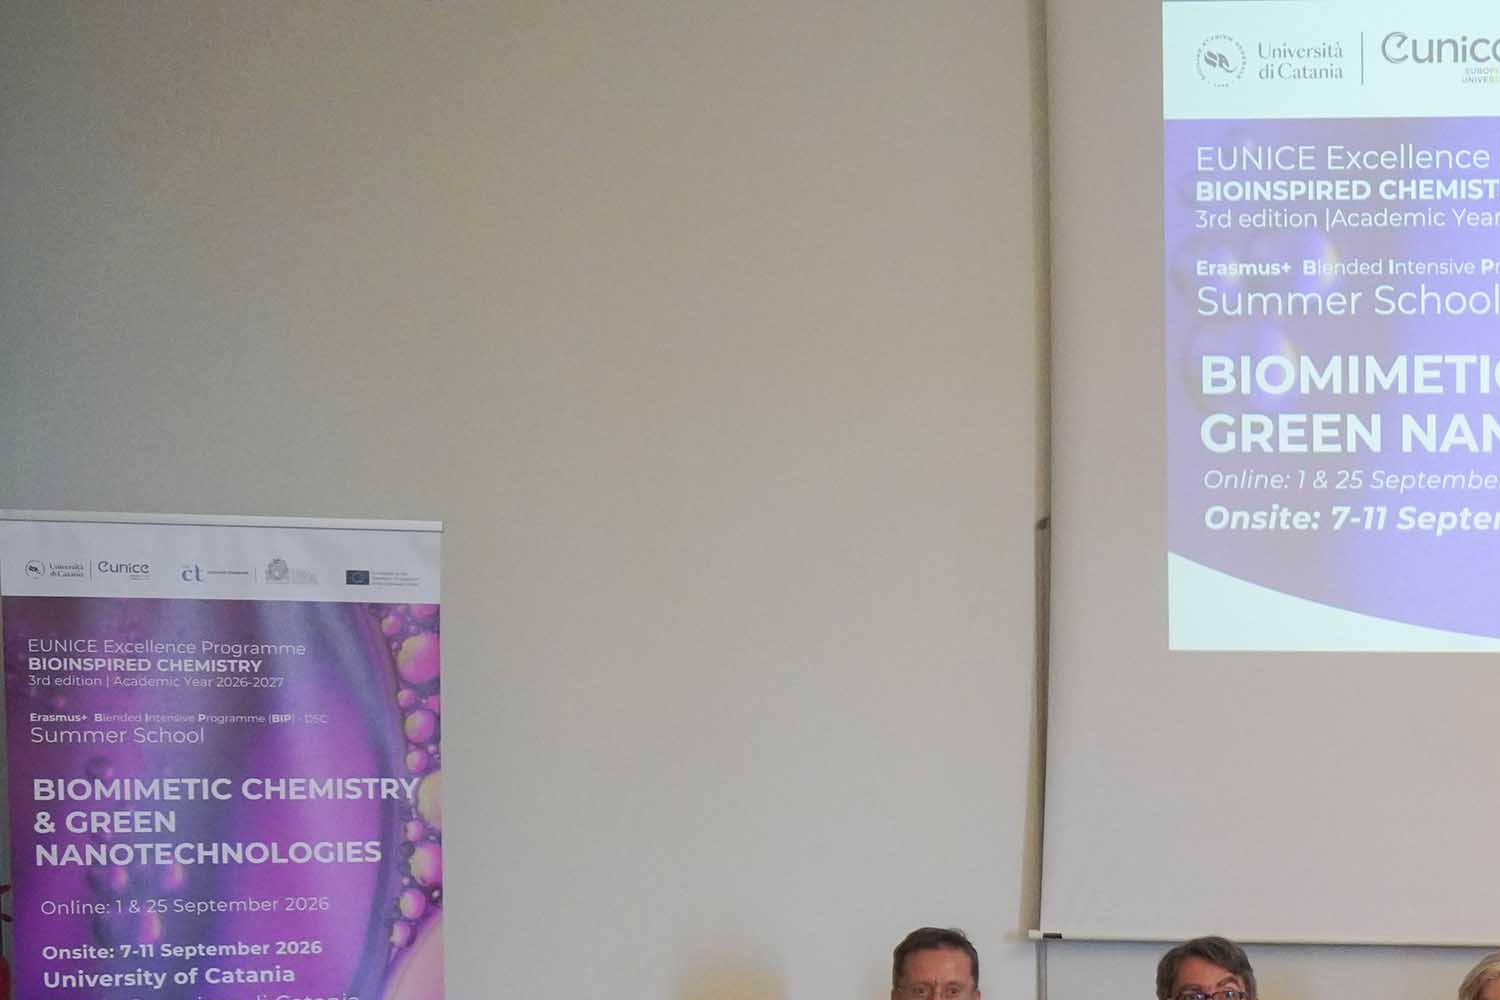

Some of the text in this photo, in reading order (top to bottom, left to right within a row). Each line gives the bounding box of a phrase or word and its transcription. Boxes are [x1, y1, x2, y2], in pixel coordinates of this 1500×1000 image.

[1258, 41, 1344, 59] Università
[1277, 63, 1344, 80] Catania
[1197, 143, 1315, 171] EUNICE
[1327, 143, 1490, 170] Excellence
[1196, 179, 1371, 201] BIOINSPIRED
[1195, 208, 1231, 228] 3rd
[1238, 207, 1317, 228] edition
[1196, 259, 1291, 278] Erasmus+
[1302, 258, 1382, 276] Blended
[1388, 258, 1475, 275] Intensive
[1197, 282, 1499, 316] Summer School
[1200, 413, 1381, 453] GREEN
[1204, 469, 1290, 488] Online:
[1296, 470, 1306, 488] 1
[1312, 470, 1327, 488] &
[1335, 469, 1363, 489] 25
[1204, 503, 1320, 530] Onsite:
[1331, 505, 1387, 530] 7-11
[28, 638, 306, 658] EUNICE Excellence Programme
[28, 656, 262, 672] BIOINSPIRED CHEMISTRY
[28, 674, 284, 688] 3rd edition Academic Year 2026-2027
[30, 712, 87, 722] Erasmus+
[197, 712, 265, 724] Programme
[268, 713, 294, 723] (BIP)
[30, 726, 204, 744] Summer School
[33, 777, 422, 802] BIOMIMETIC CHEMISTRY
[33, 810, 175, 833] & GREEN
[36, 840, 381, 868] NANOTECHNOLOGIES
[40, 896, 330, 915] Online: 1 & 25 September 2026
[42, 940, 322, 960] Onsite: 7-11 September 2026
[44, 964, 294, 991] University of Catania
